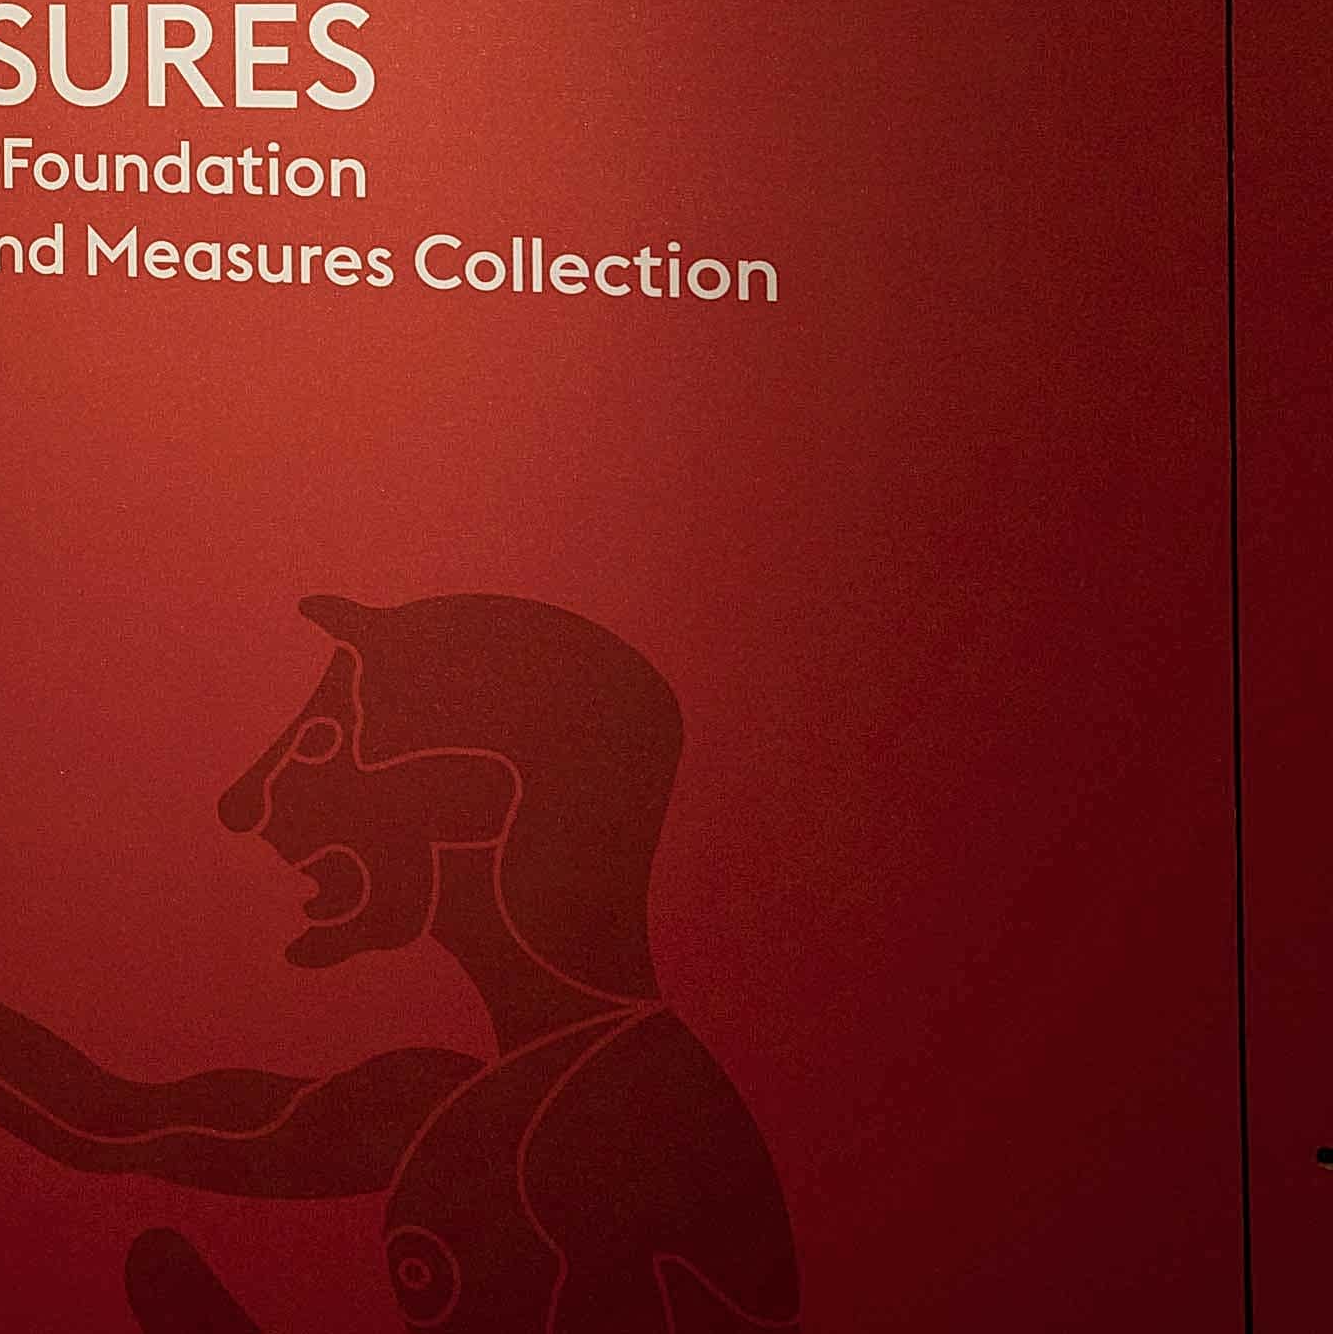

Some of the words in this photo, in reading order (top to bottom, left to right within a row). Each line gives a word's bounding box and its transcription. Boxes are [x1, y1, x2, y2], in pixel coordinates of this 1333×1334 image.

[3, 140, 366, 198] Foundation
[87, 224, 394, 288] Measures
[414, 234, 778, 302] Collection
